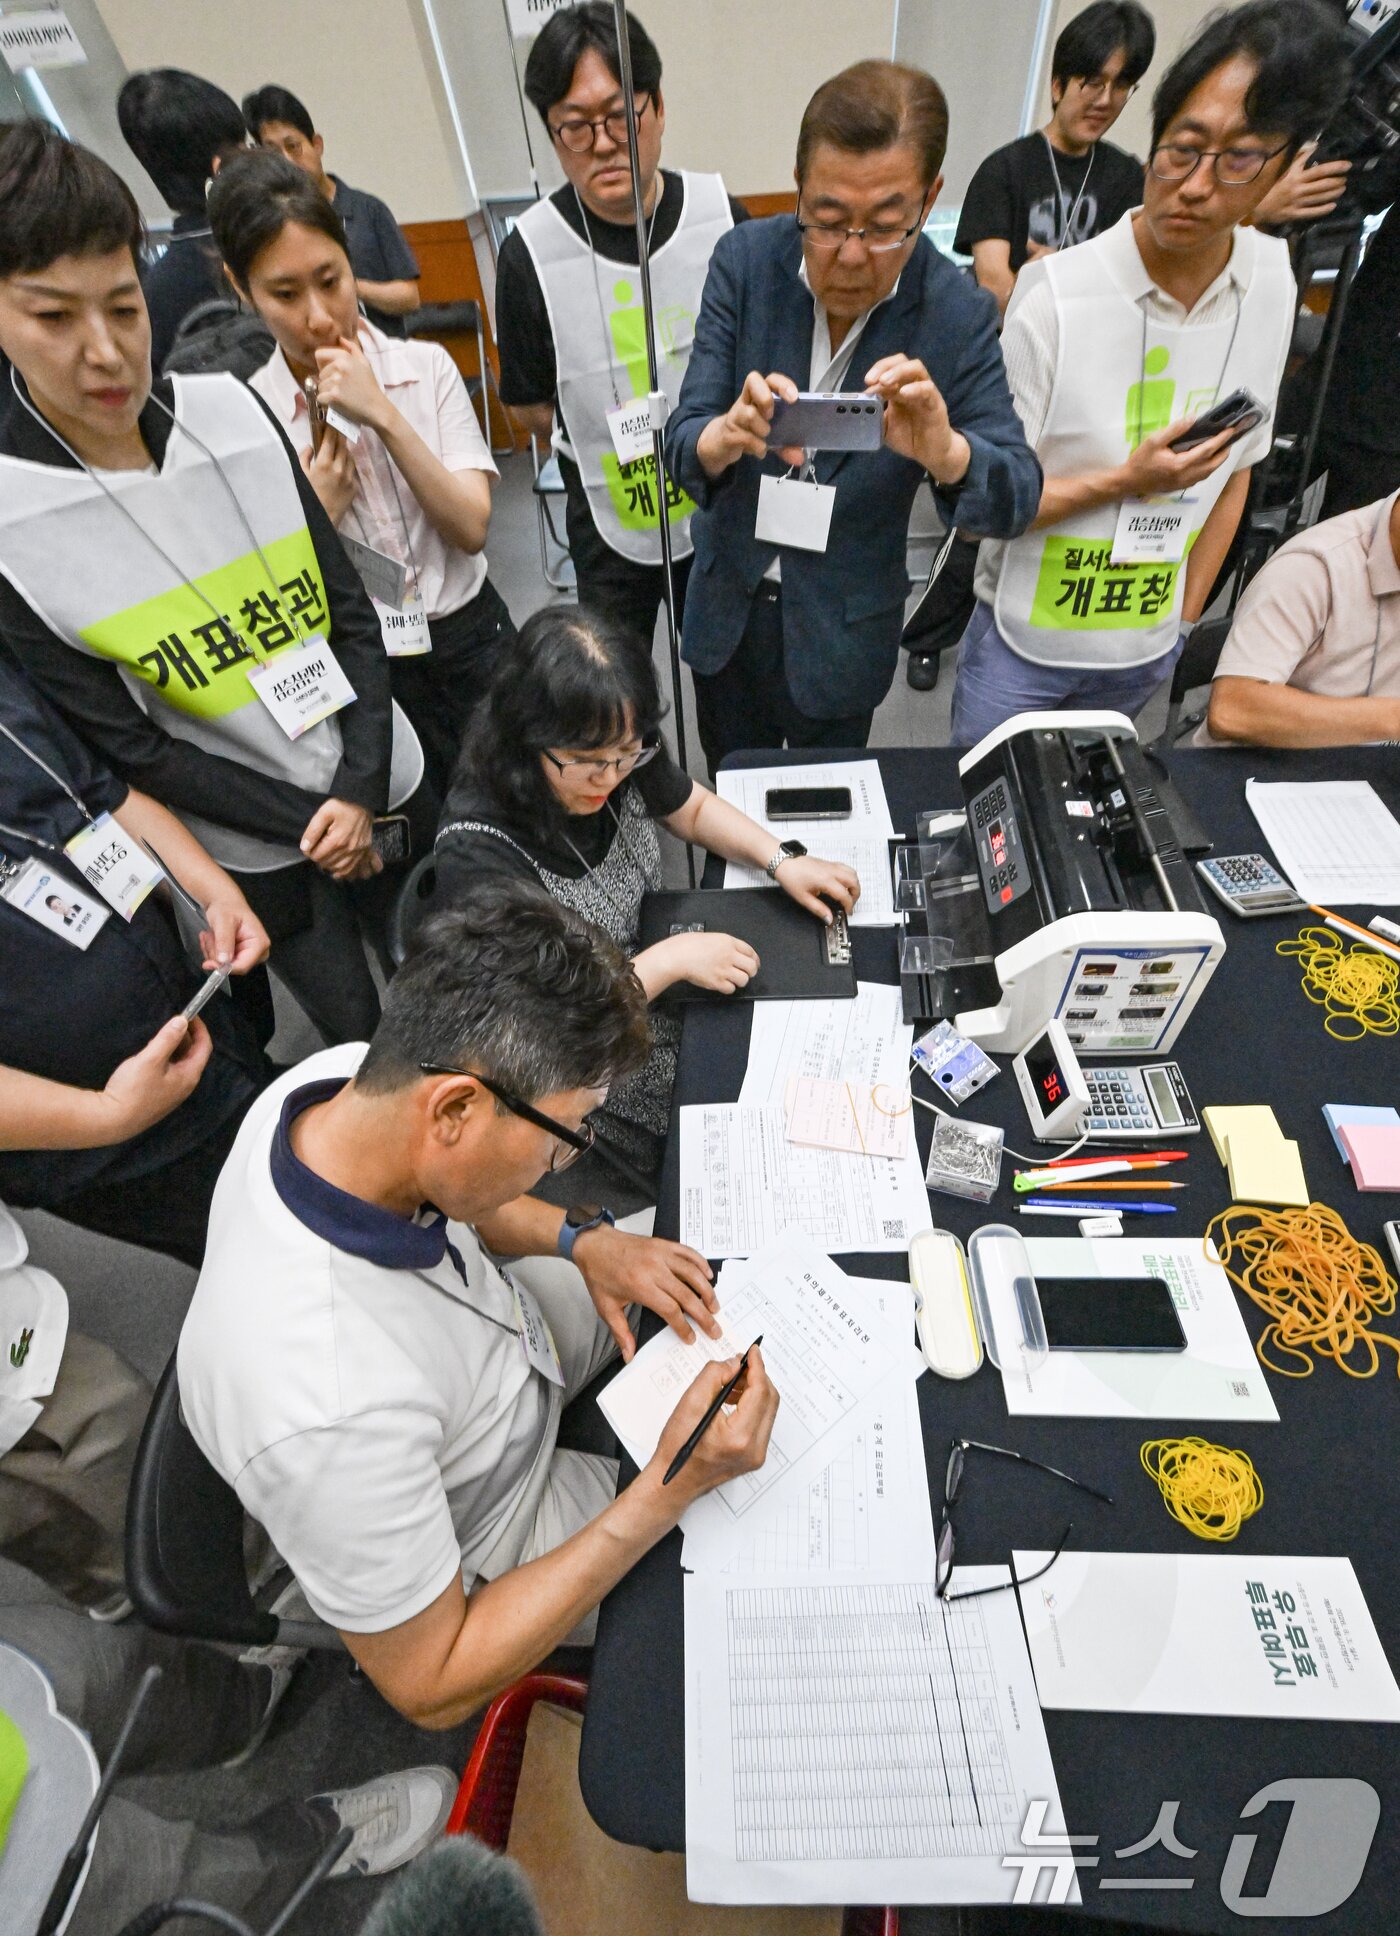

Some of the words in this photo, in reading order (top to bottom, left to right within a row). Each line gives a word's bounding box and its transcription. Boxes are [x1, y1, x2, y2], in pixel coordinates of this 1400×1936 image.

[137, 568, 327, 692] 개표참관
[271, 659, 328, 702] 검증참관인
[1043, 1073, 1062, 1102] 36
[1158, 1254, 1190, 1311] 개표관리
[1245, 1579, 1297, 1686] 투표예시
[1271, 1589, 1319, 1678] 유·무효
